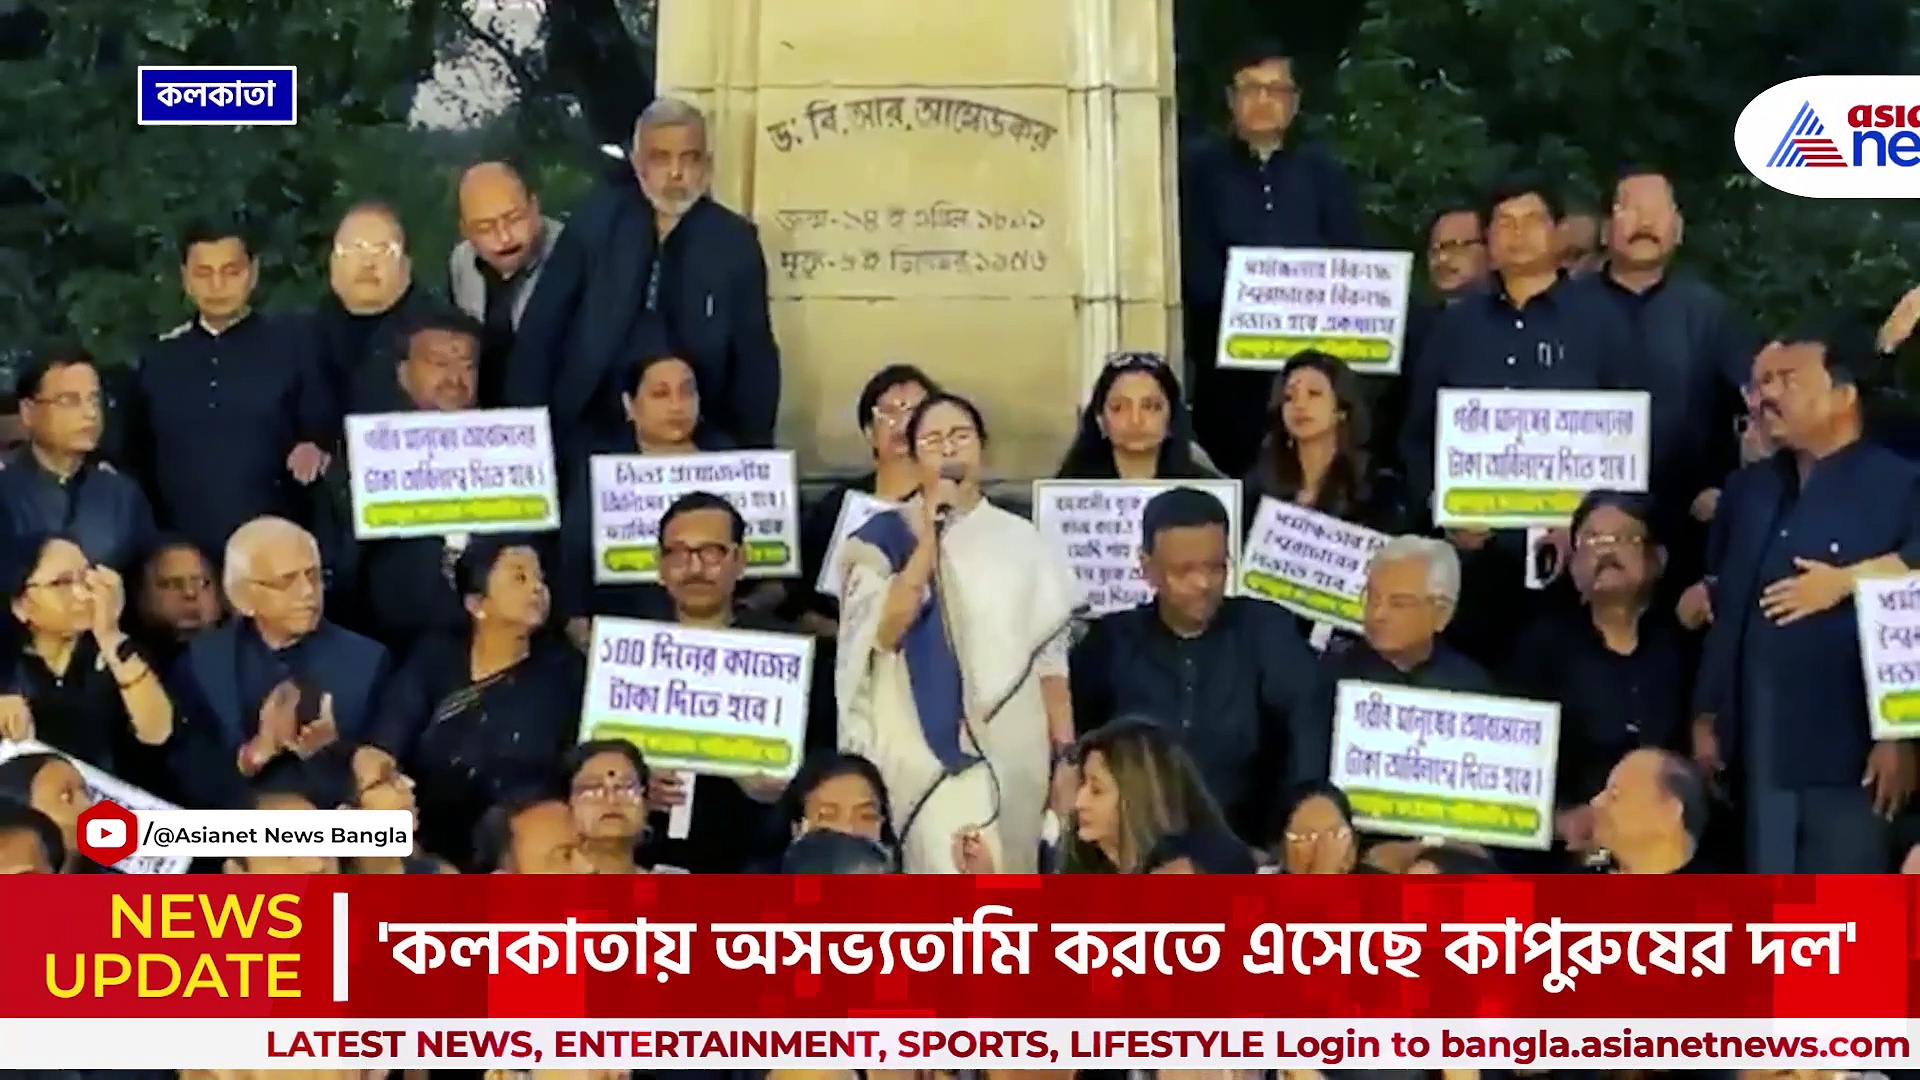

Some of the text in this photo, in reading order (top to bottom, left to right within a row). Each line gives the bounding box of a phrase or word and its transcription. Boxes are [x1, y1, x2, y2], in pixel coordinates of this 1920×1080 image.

[651, 631, 717, 676] দিনের
[723, 647, 802, 684] কাজের
[609, 675, 660, 715] টাকা
[665, 678, 722, 718] দিতে
